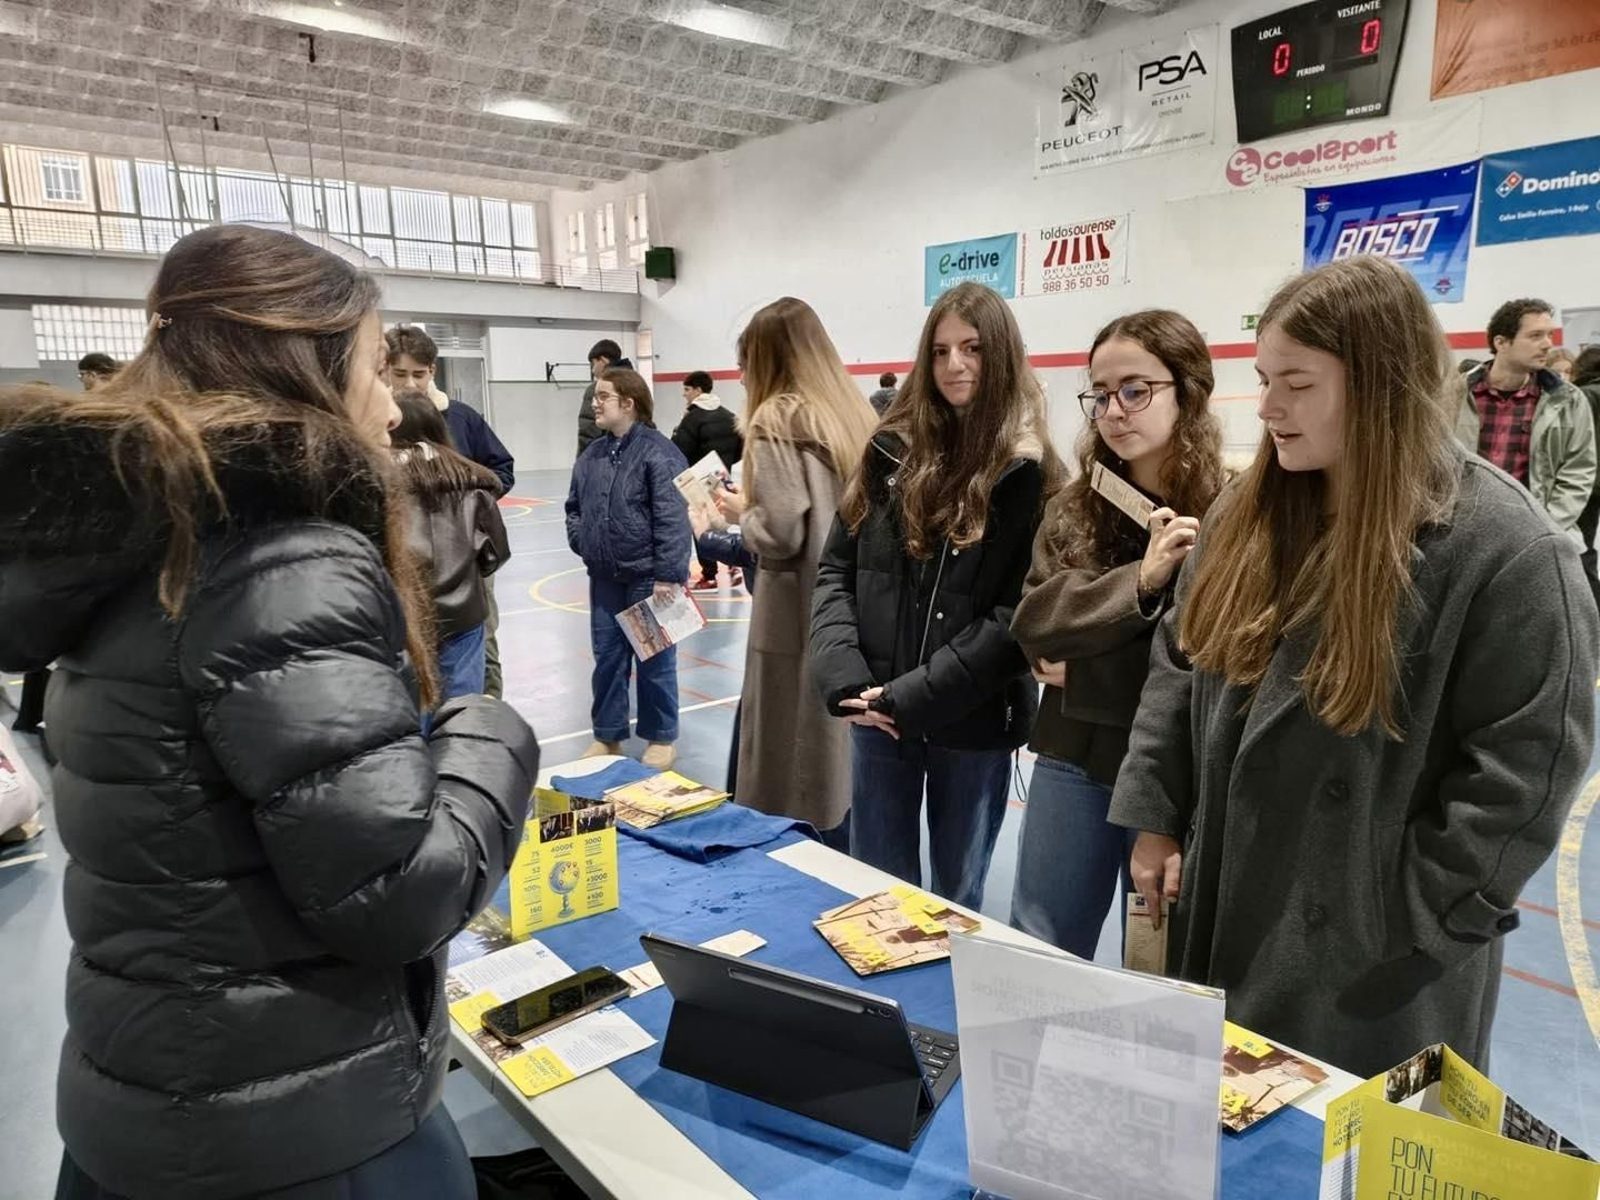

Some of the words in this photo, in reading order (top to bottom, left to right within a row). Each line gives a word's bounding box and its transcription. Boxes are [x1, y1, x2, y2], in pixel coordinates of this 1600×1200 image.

[1337, 0, 1381, 18] VISITANTE
[1258, 26, 1282, 40] LOCAL
[1361, 18, 1380, 53] 0
[1138, 50, 1207, 91] PSA
[1273, 43, 1290, 74] 0
[1296, 64, 1325, 77] PERIODO
[1151, 92, 1191, 107] RETAIL
[1345, 103, 1381, 116] MONDO
[1041, 125, 1123, 152] PEUGEOT
[1263, 167, 1322, 183] Especialistas
[1324, 164, 1336, 173] en
[1332, 217, 1440, 262] BOSCO
[939, 250, 999, 275] e-drive
[1042, 281, 1061, 293] 988
[1064, 278, 1077, 291] 36
[1080, 276, 1092, 289] 50
[1096, 274, 1109, 286] 50
[1391, 1137, 1433, 1174] PON
[1391, 1164, 1416, 1196] TU
[1422, 1174, 1501, 1200] FUT
